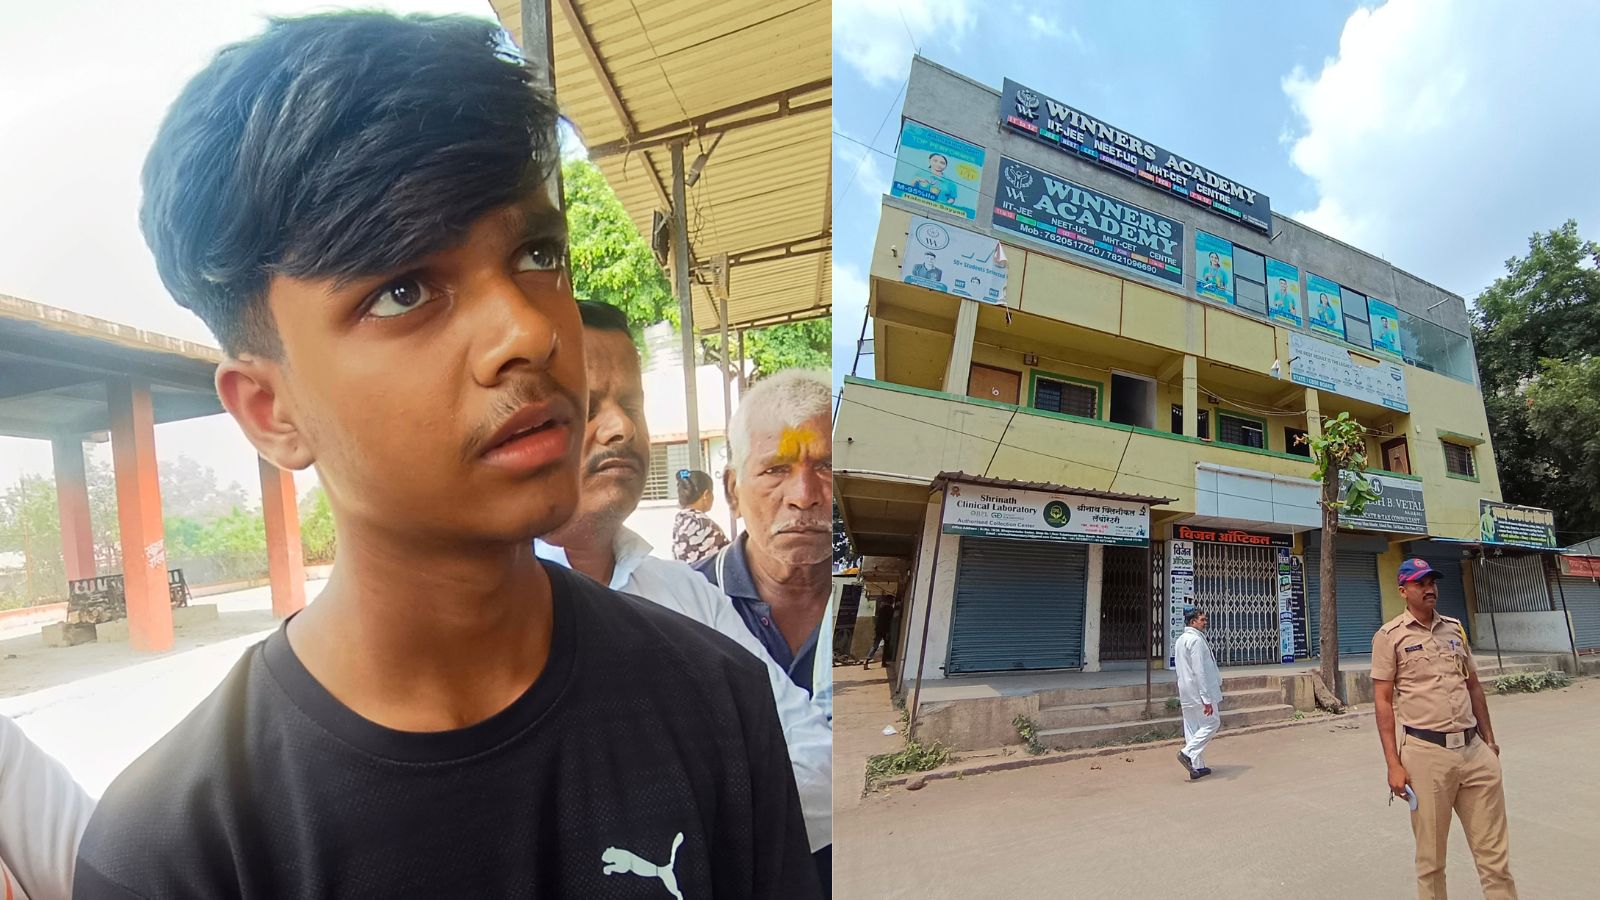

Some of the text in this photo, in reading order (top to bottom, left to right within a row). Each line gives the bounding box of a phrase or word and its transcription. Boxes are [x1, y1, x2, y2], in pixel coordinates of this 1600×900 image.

[1046, 99, 1257, 204] WINNERS ACADEMY
[1047, 119, 1084, 143] IIT-JEE
[1094, 140, 1138, 166] NEET-UG
[1146, 162, 1188, 186] MHT-CET
[1196, 183, 1231, 206] CENTRE
[1005, 186, 1026, 203] WA
[1043, 176, 1172, 238] WINNERS
[1003, 200, 1034, 217] IIT-JEE
[1051, 218, 1088, 235] NEET-UG
[1102, 234, 1138, 252] MHT-CET
[1149, 251, 1177, 266] CENTRE
[1033, 194, 1178, 255] ACADEMY
[1020, 223, 1039, 236] Mob
[1044, 231, 1100, 255] 7620517720
[1107, 251, 1157, 274] 7821096690
[964, 261, 985, 273] Students
[956, 500, 990, 510] Clinical
[992, 503, 1038, 515] Laboratory
[981, 494, 1017, 504] Shrinath
[1396, 499, 1425, 512] VETAL
[989, 520, 1016, 528] Collection
[1179, 526, 1271, 545] विजन ऑप्टिकल
